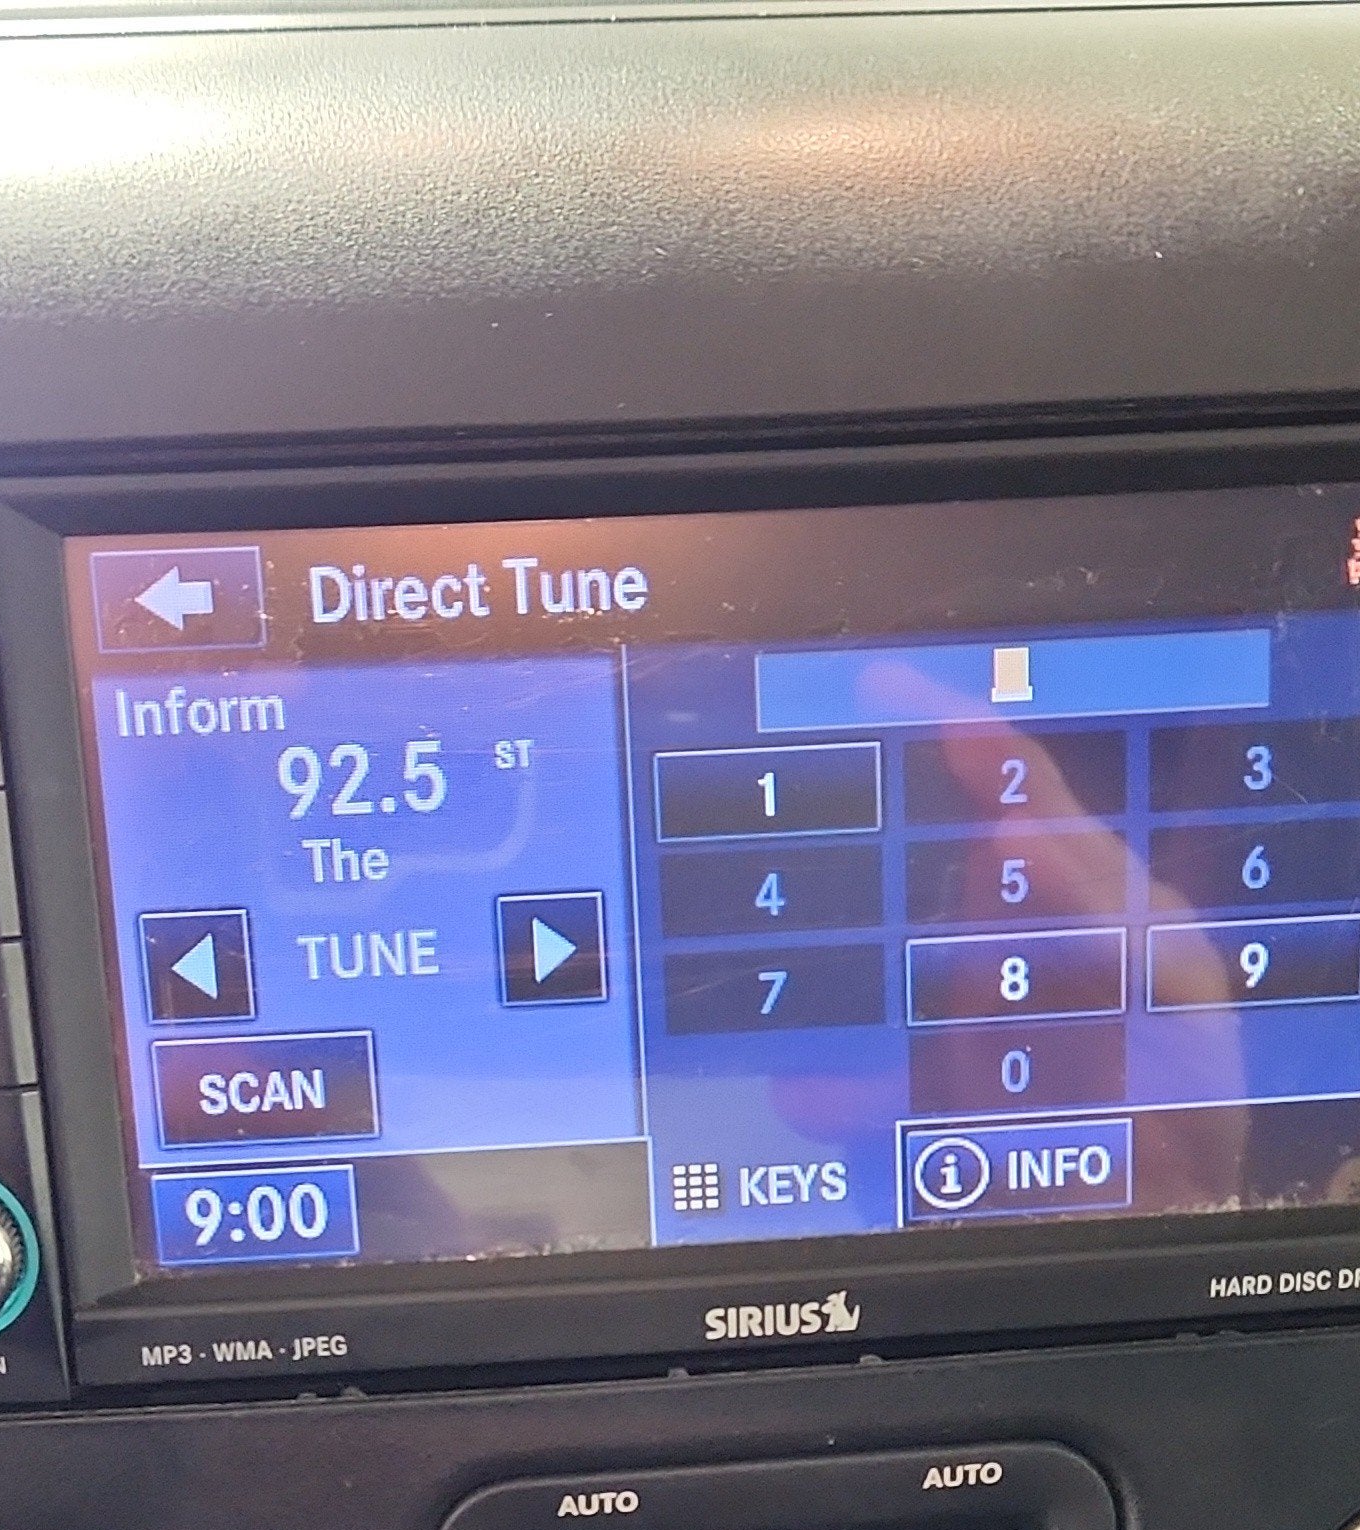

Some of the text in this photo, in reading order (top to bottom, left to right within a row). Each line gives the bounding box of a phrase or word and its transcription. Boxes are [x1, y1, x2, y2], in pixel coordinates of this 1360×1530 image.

[308, 556, 649, 625] Direct Tune
[115, 686, 286, 738] Inform
[277, 739, 535, 820] 92.5 ST
[1000, 759, 1029, 804] 2
[1243, 745, 1273, 791] 3
[756, 771, 777, 818] 1
[301, 837, 390, 884] The
[1000, 858, 1030, 903] 5
[1241, 846, 1271, 890] 6
[755, 872, 786, 917] 4
[296, 930, 441, 980] TUNE
[1240, 943, 1270, 989] 9
[757, 970, 788, 1015] 7
[1000, 956, 1030, 1002] 8
[198, 1068, 326, 1116] SCAN
[1000, 1049, 1030, 1095] 0
[739, 1161, 848, 1208] KEYS
[1006, 1145, 1112, 1191] INFO
[184, 1182, 329, 1247] 9:00
[1208, 1270, 1273, 1299] HARD
[1278, 1268, 1332, 1294] DISC
[704, 1302, 821, 1340] SIRIUS
[140, 1334, 349, 1368] MP3 WMA JPEG
[921, 1461, 1004, 1491] AUTO
[557, 1490, 640, 1518] AUTO
